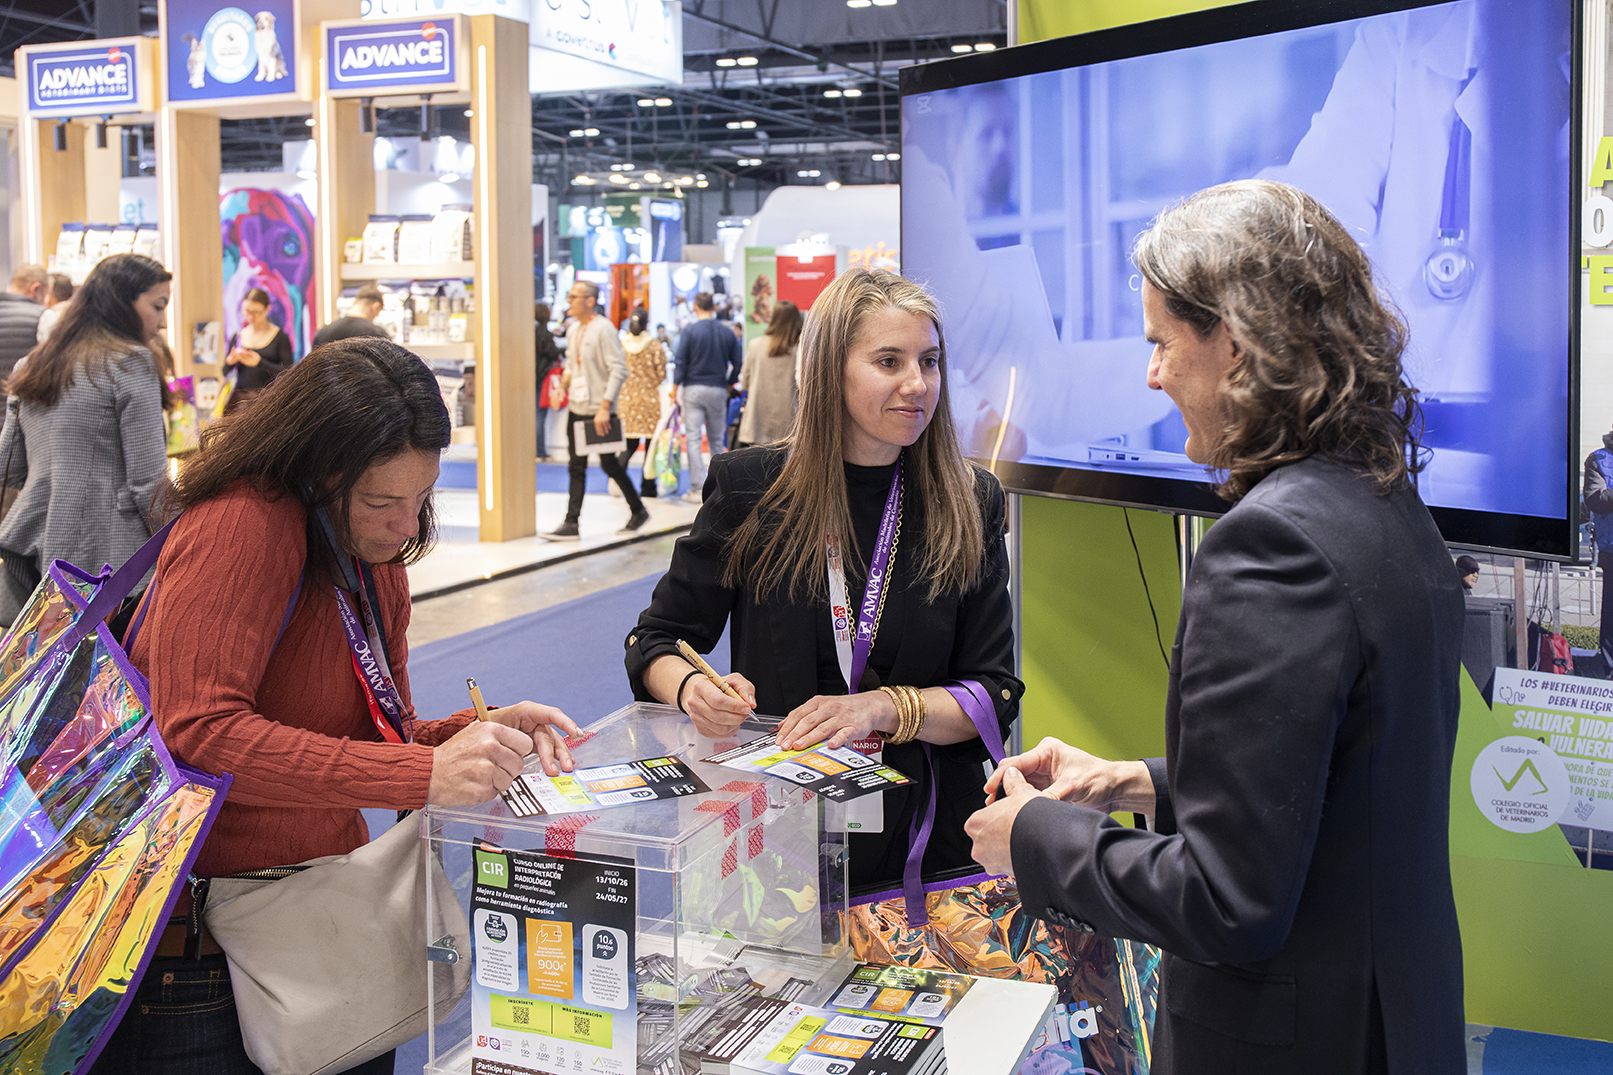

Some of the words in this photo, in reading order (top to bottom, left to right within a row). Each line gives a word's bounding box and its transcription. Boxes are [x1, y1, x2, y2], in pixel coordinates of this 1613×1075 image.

[340, 40, 443, 70] ADVANCE
[39, 63, 127, 90] ADVANCE
[864, 567, 883, 618] AMVAC
[354, 640, 387, 692] AMVAC
[1520, 678, 1539, 689] LOS
[1541, 681, 1613, 699] #VETERINARIOS
[1548, 695, 1578, 708] DEBEN
[1580, 700, 1613, 713] ELEGIR
[1512, 709, 1575, 735] SALVAR
[1501, 745, 1525, 755] Editado
[1585, 765, 1595, 775] DE
[1597, 767, 1613, 777] QUE
[1600, 779, 1610, 788] SE
[1574, 786, 1584, 796] DE
[1586, 788, 1595, 798] LA
[1491, 799, 1521, 808] COLEGIO
[1523, 802, 1549, 810] OFICIAL
[1505, 807, 1549, 818] VETERINARIOS
[1510, 815, 1535, 824] MADRID
[482, 861, 504, 876] CIR
[513, 858, 533, 867] CURSO
[533, 861, 556, 870] ONLINE
[557, 863, 564, 871] DE
[514, 866, 562, 880] INTERPRETACIÓN
[514, 874, 552, 887] RADIOLÓGICA
[595, 876, 628, 887] 13/10/26
[476, 887, 495, 896] Mejora
[502, 891, 528, 903] formación
[536, 899, 568, 909] radiografía
[595, 892, 628, 904] 24/05/27
[490, 898, 522, 910] herramienta
[522, 904, 555, 915] diagnóstica
[596, 943, 614, 951] puntos
[572, 1008, 603, 1018] INFORMACIÓN
